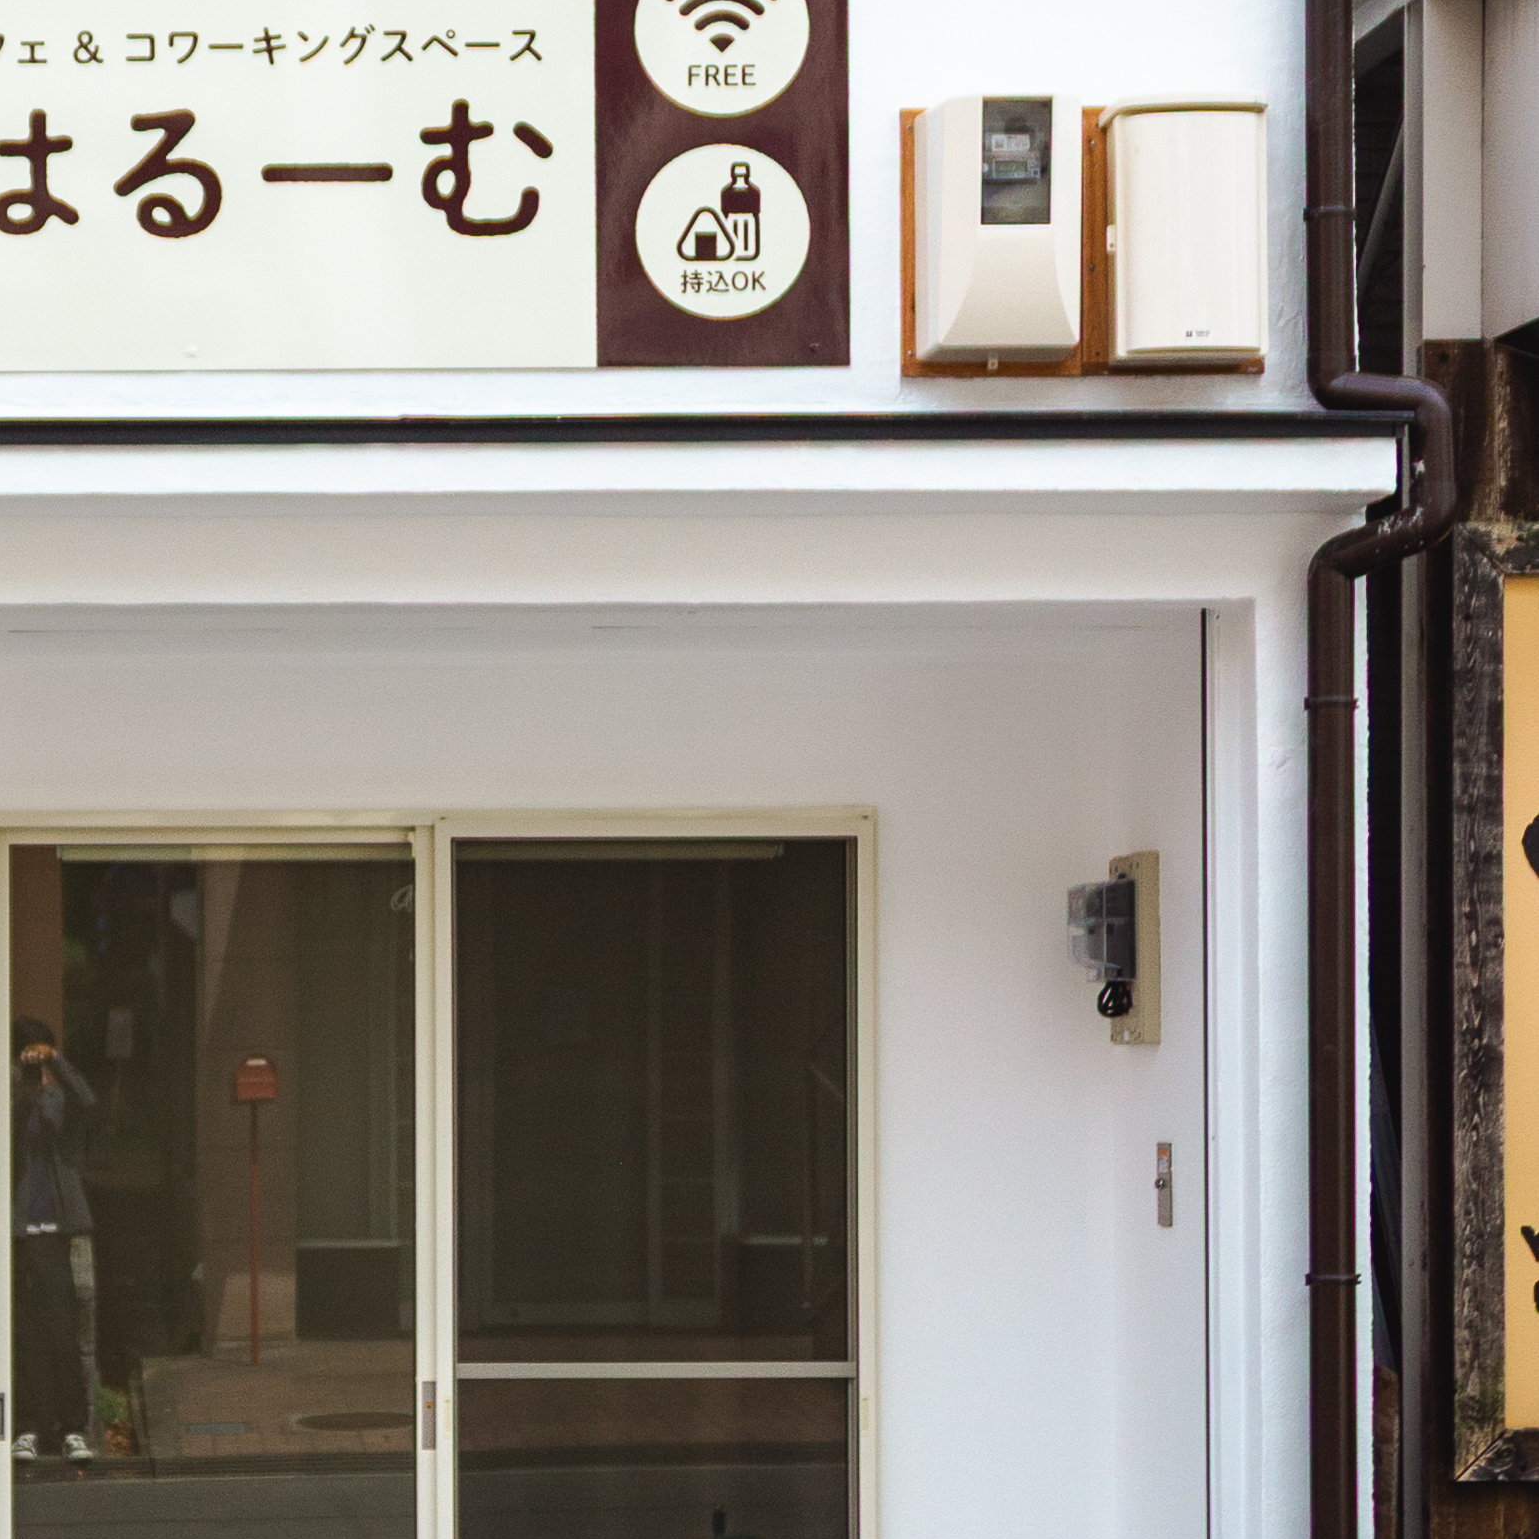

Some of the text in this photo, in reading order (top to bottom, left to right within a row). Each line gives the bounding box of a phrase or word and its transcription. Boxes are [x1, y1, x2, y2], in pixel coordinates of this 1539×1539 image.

[72, 30, 104, 65] &
[126, 24, 543, 66] コワーキングスペース
[687, 64, 756, 87] FREE
[681, 269, 767, 294] 持込OK
